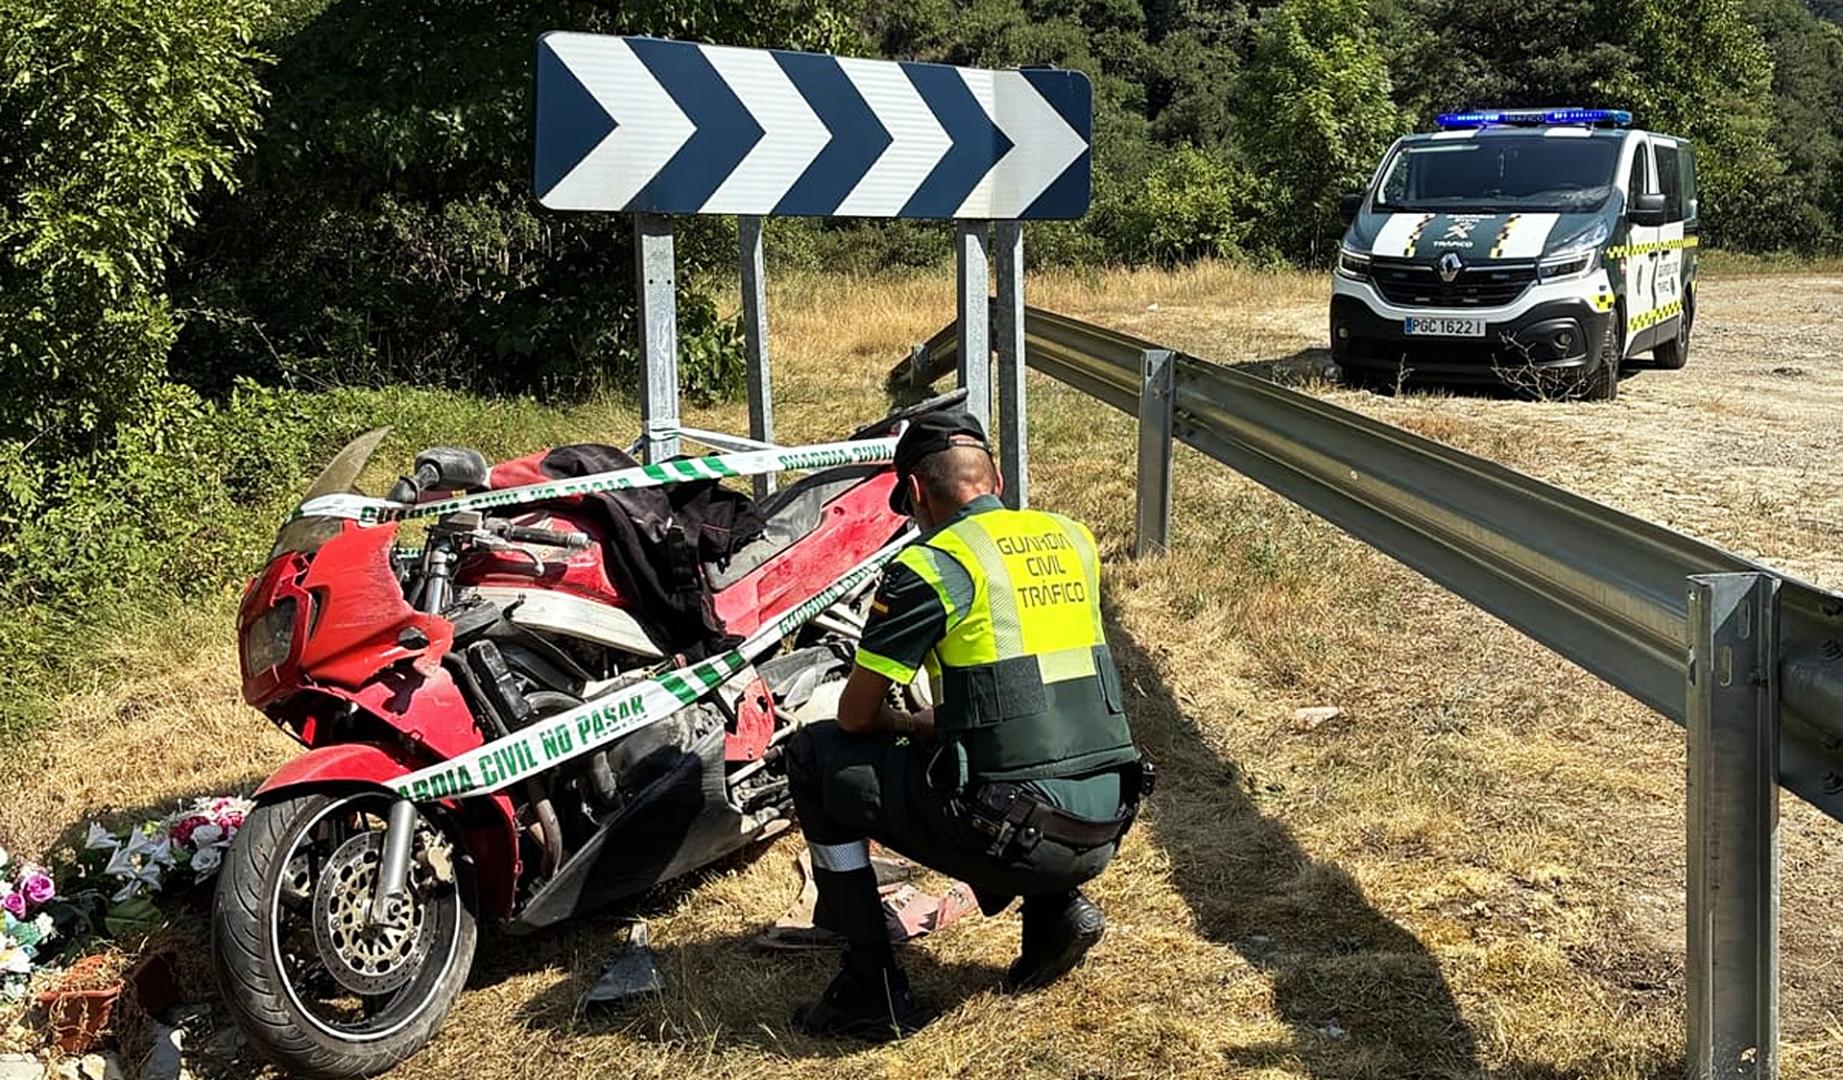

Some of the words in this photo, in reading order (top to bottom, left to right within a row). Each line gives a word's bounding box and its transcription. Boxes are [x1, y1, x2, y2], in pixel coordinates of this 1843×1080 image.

[1412, 319, 1437, 333] PGC
[1440, 319, 1473, 335] 1622
[996, 532, 1074, 556] GUARDIA
[1026, 555, 1067, 577] CIVIL
[1017, 580, 1086, 609] TRÁFICO
[478, 739, 540, 788] CIVIL
[538, 723, 574, 761] NO
